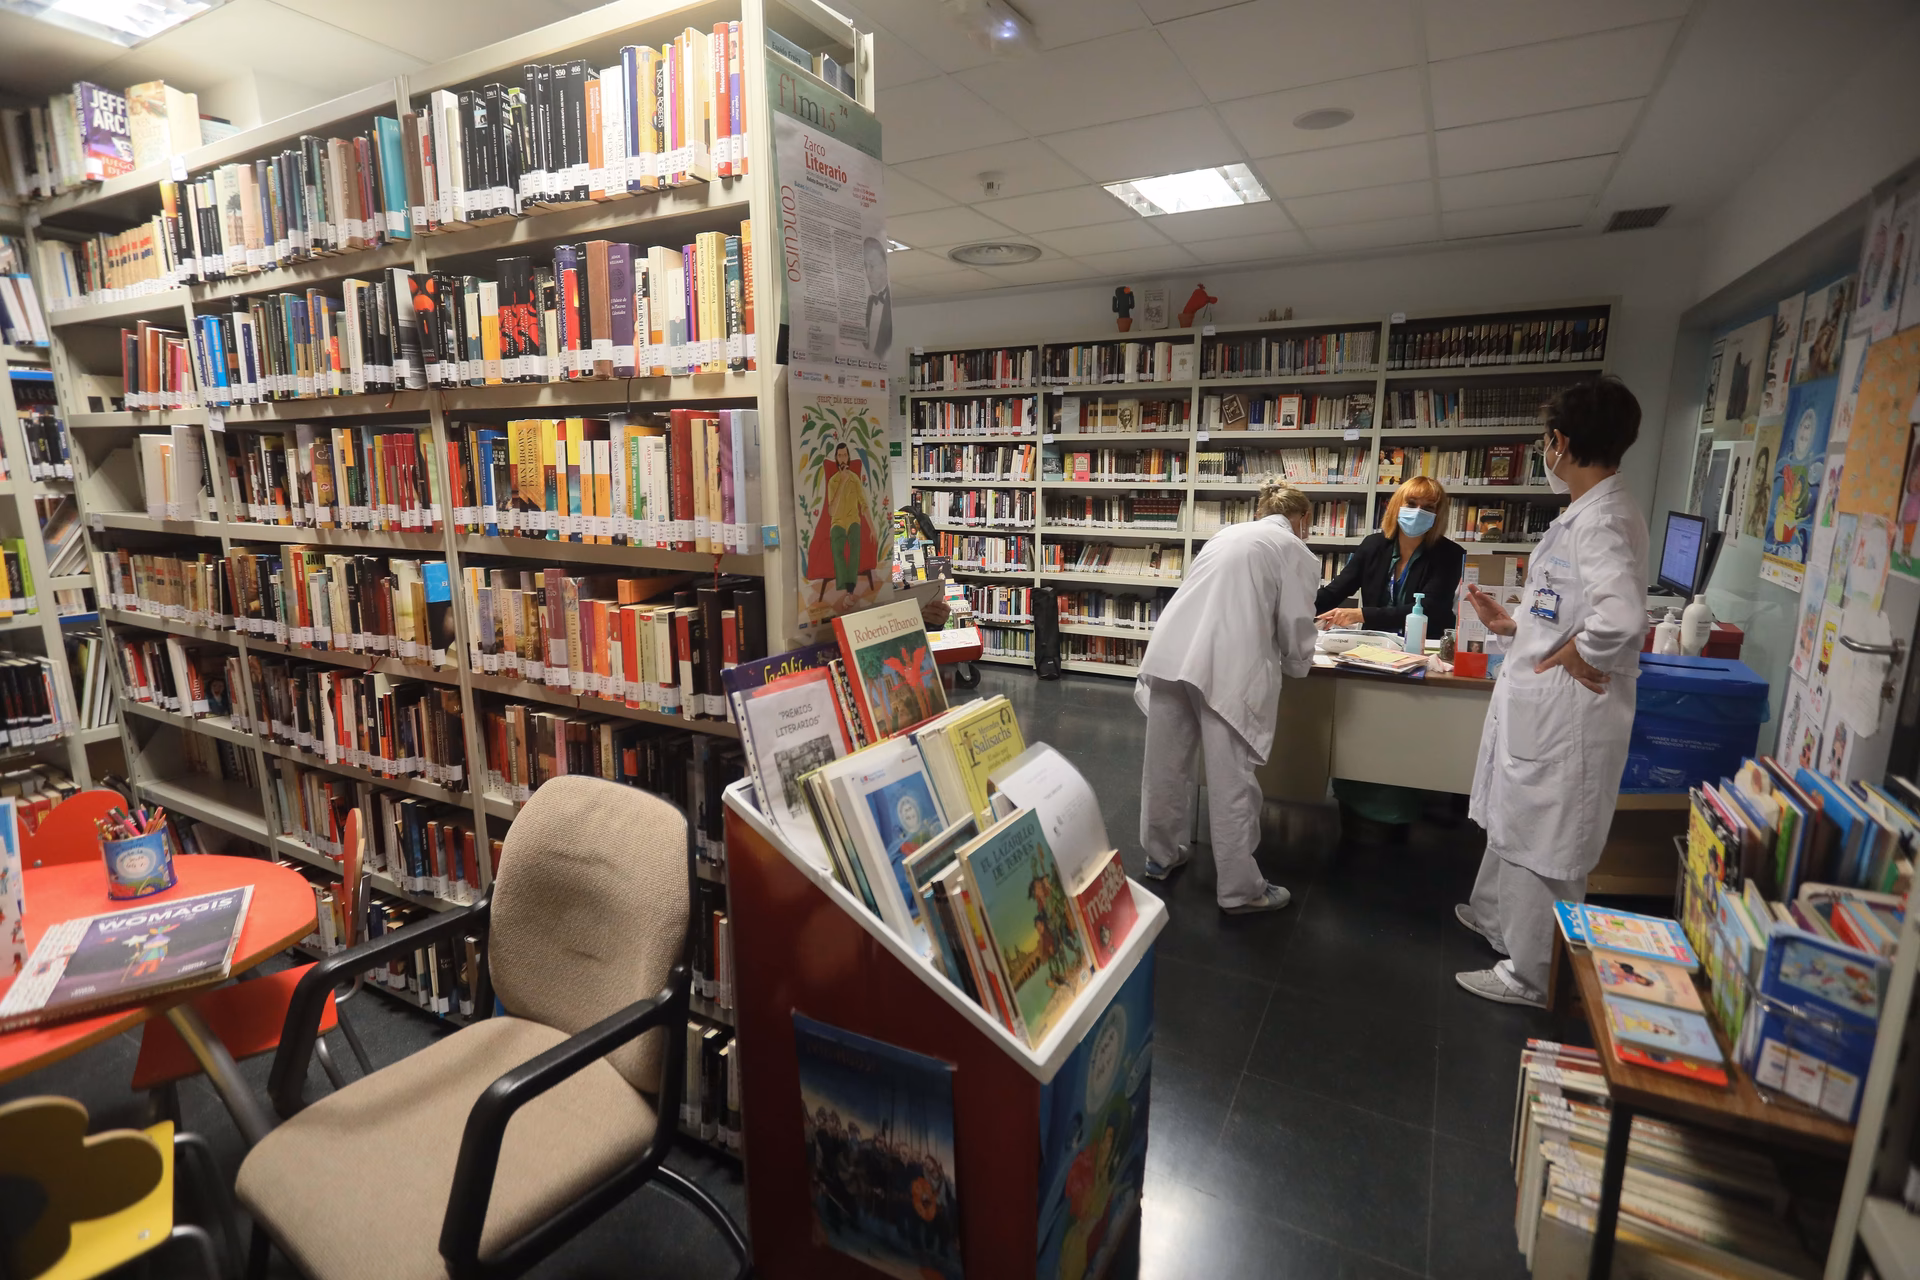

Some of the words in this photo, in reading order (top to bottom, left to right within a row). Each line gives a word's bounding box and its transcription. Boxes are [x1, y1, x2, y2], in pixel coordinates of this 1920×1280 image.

[90, 89, 126, 115] JEFF
[804, 134, 826, 156] Zarco
[805, 151, 847, 184] Literario
[781, 185, 801, 283] concurso
[518, 429, 526, 465] BROWN
[854, 625, 889, 643] Roberto
[888, 616, 919, 633] Elbanco
[778, 704, 813, 720] "PREMIOS
[775, 715, 821, 738] LITERARIOS"
[973, 727, 1012, 755] Salisachs
[992, 824, 1035, 863] LAZARILLO
[98, 897, 234, 932] WOMAGIS
